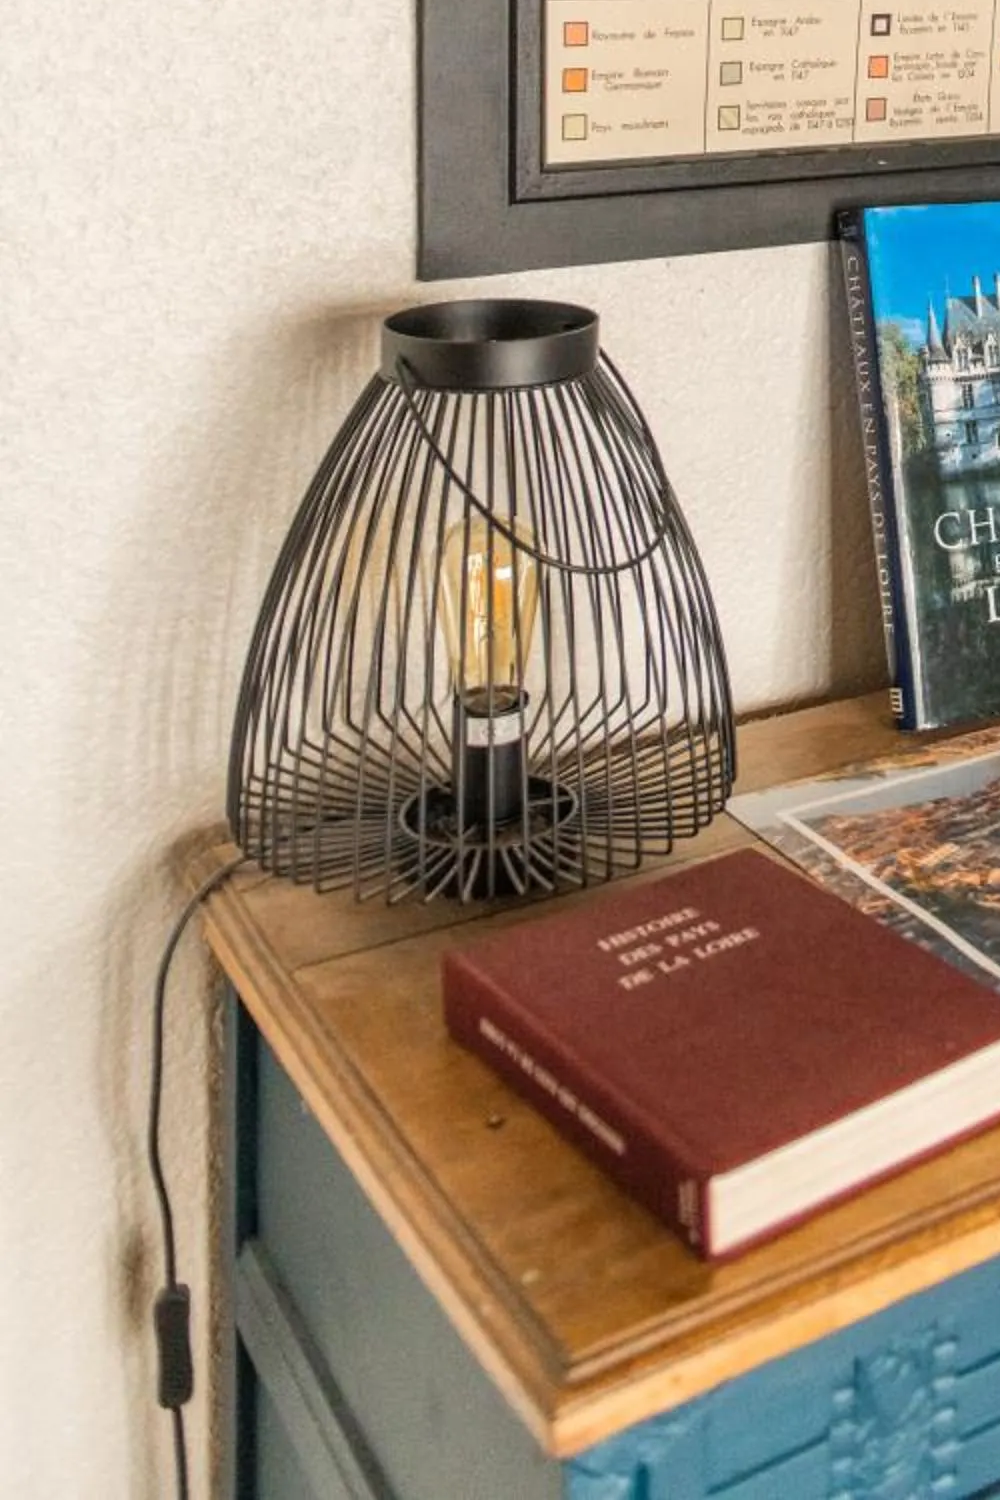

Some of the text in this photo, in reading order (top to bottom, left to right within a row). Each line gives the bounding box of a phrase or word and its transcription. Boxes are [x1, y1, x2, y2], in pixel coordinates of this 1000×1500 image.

[597, 906, 700, 952] HISTOIRE
[618, 919, 721, 967] DES PAYS
[617, 926, 761, 991] DE LA LOIRE
